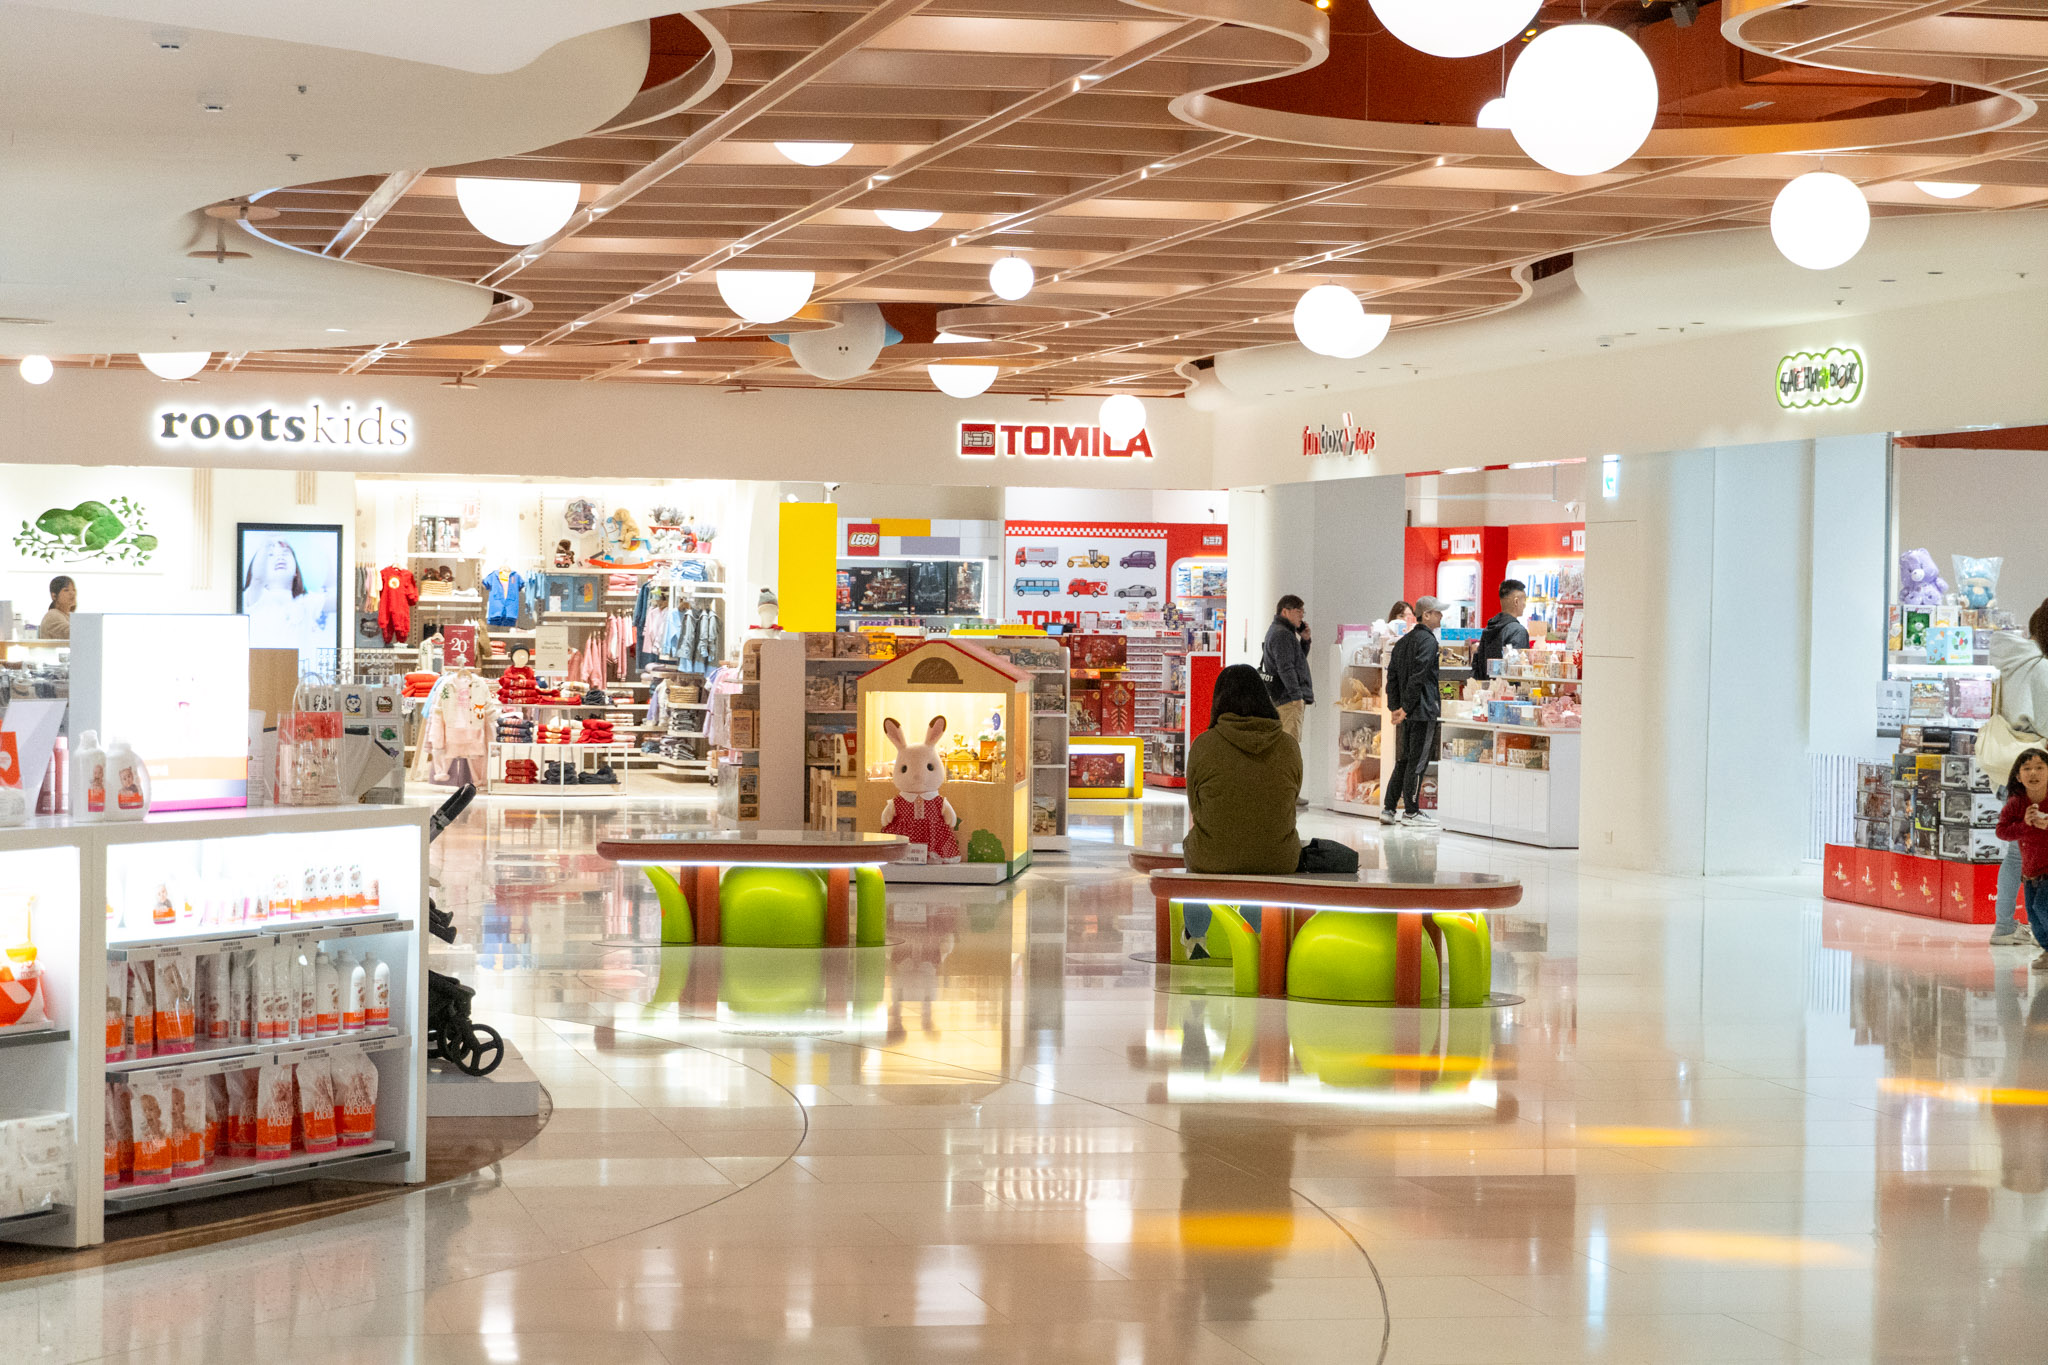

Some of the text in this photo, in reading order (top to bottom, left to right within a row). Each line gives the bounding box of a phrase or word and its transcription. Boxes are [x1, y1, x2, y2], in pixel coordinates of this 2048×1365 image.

[1829, 362, 1858, 390] BOX
[850, 533, 878, 546] LEGO
[1450, 533, 1482, 555] TOMICA
